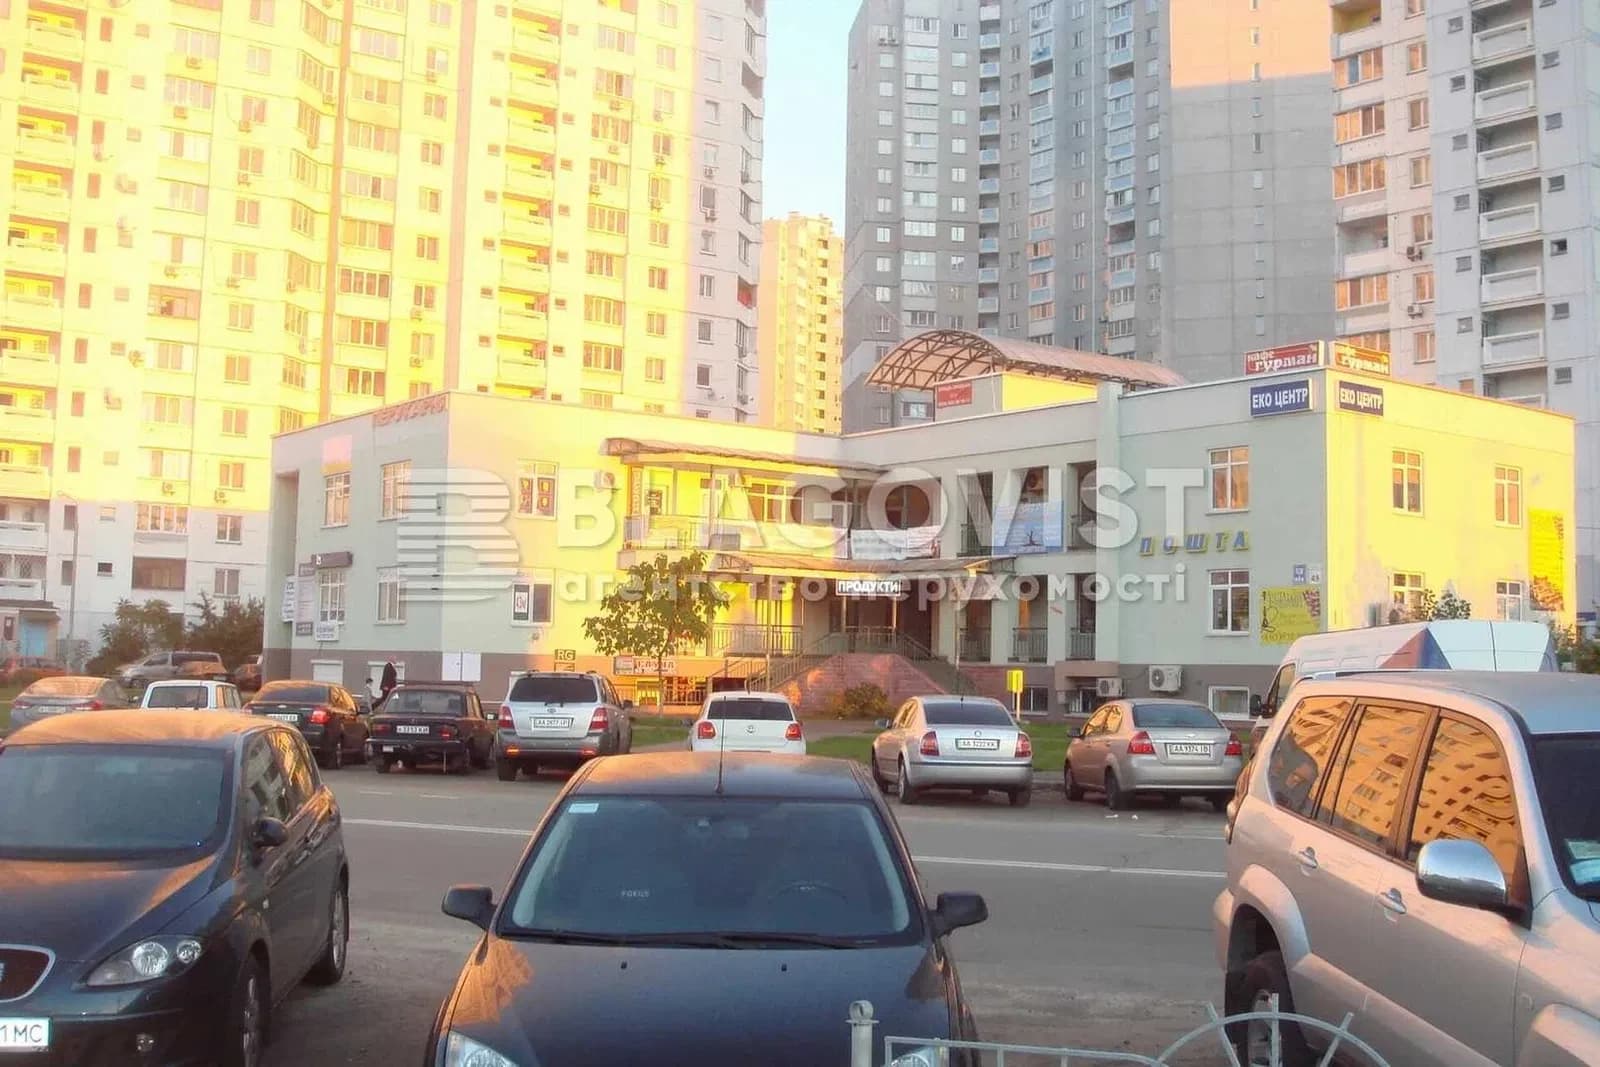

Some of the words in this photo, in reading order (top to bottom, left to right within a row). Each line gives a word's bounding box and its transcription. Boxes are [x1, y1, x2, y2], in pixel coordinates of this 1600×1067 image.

[1252, 393, 1272, 408] ЕКО
[1274, 388, 1308, 407] ЦЕНТР
[1340, 388, 1355, 404] ЕКО
[1356, 391, 1383, 409] ЦЕНТР
[1139, 529, 1250, 557] ПОШТА
[838, 581, 899, 593] ПРОДУКТИ
[558, 650, 574, 661] RG
[13, 1024, 43, 1043] MC
